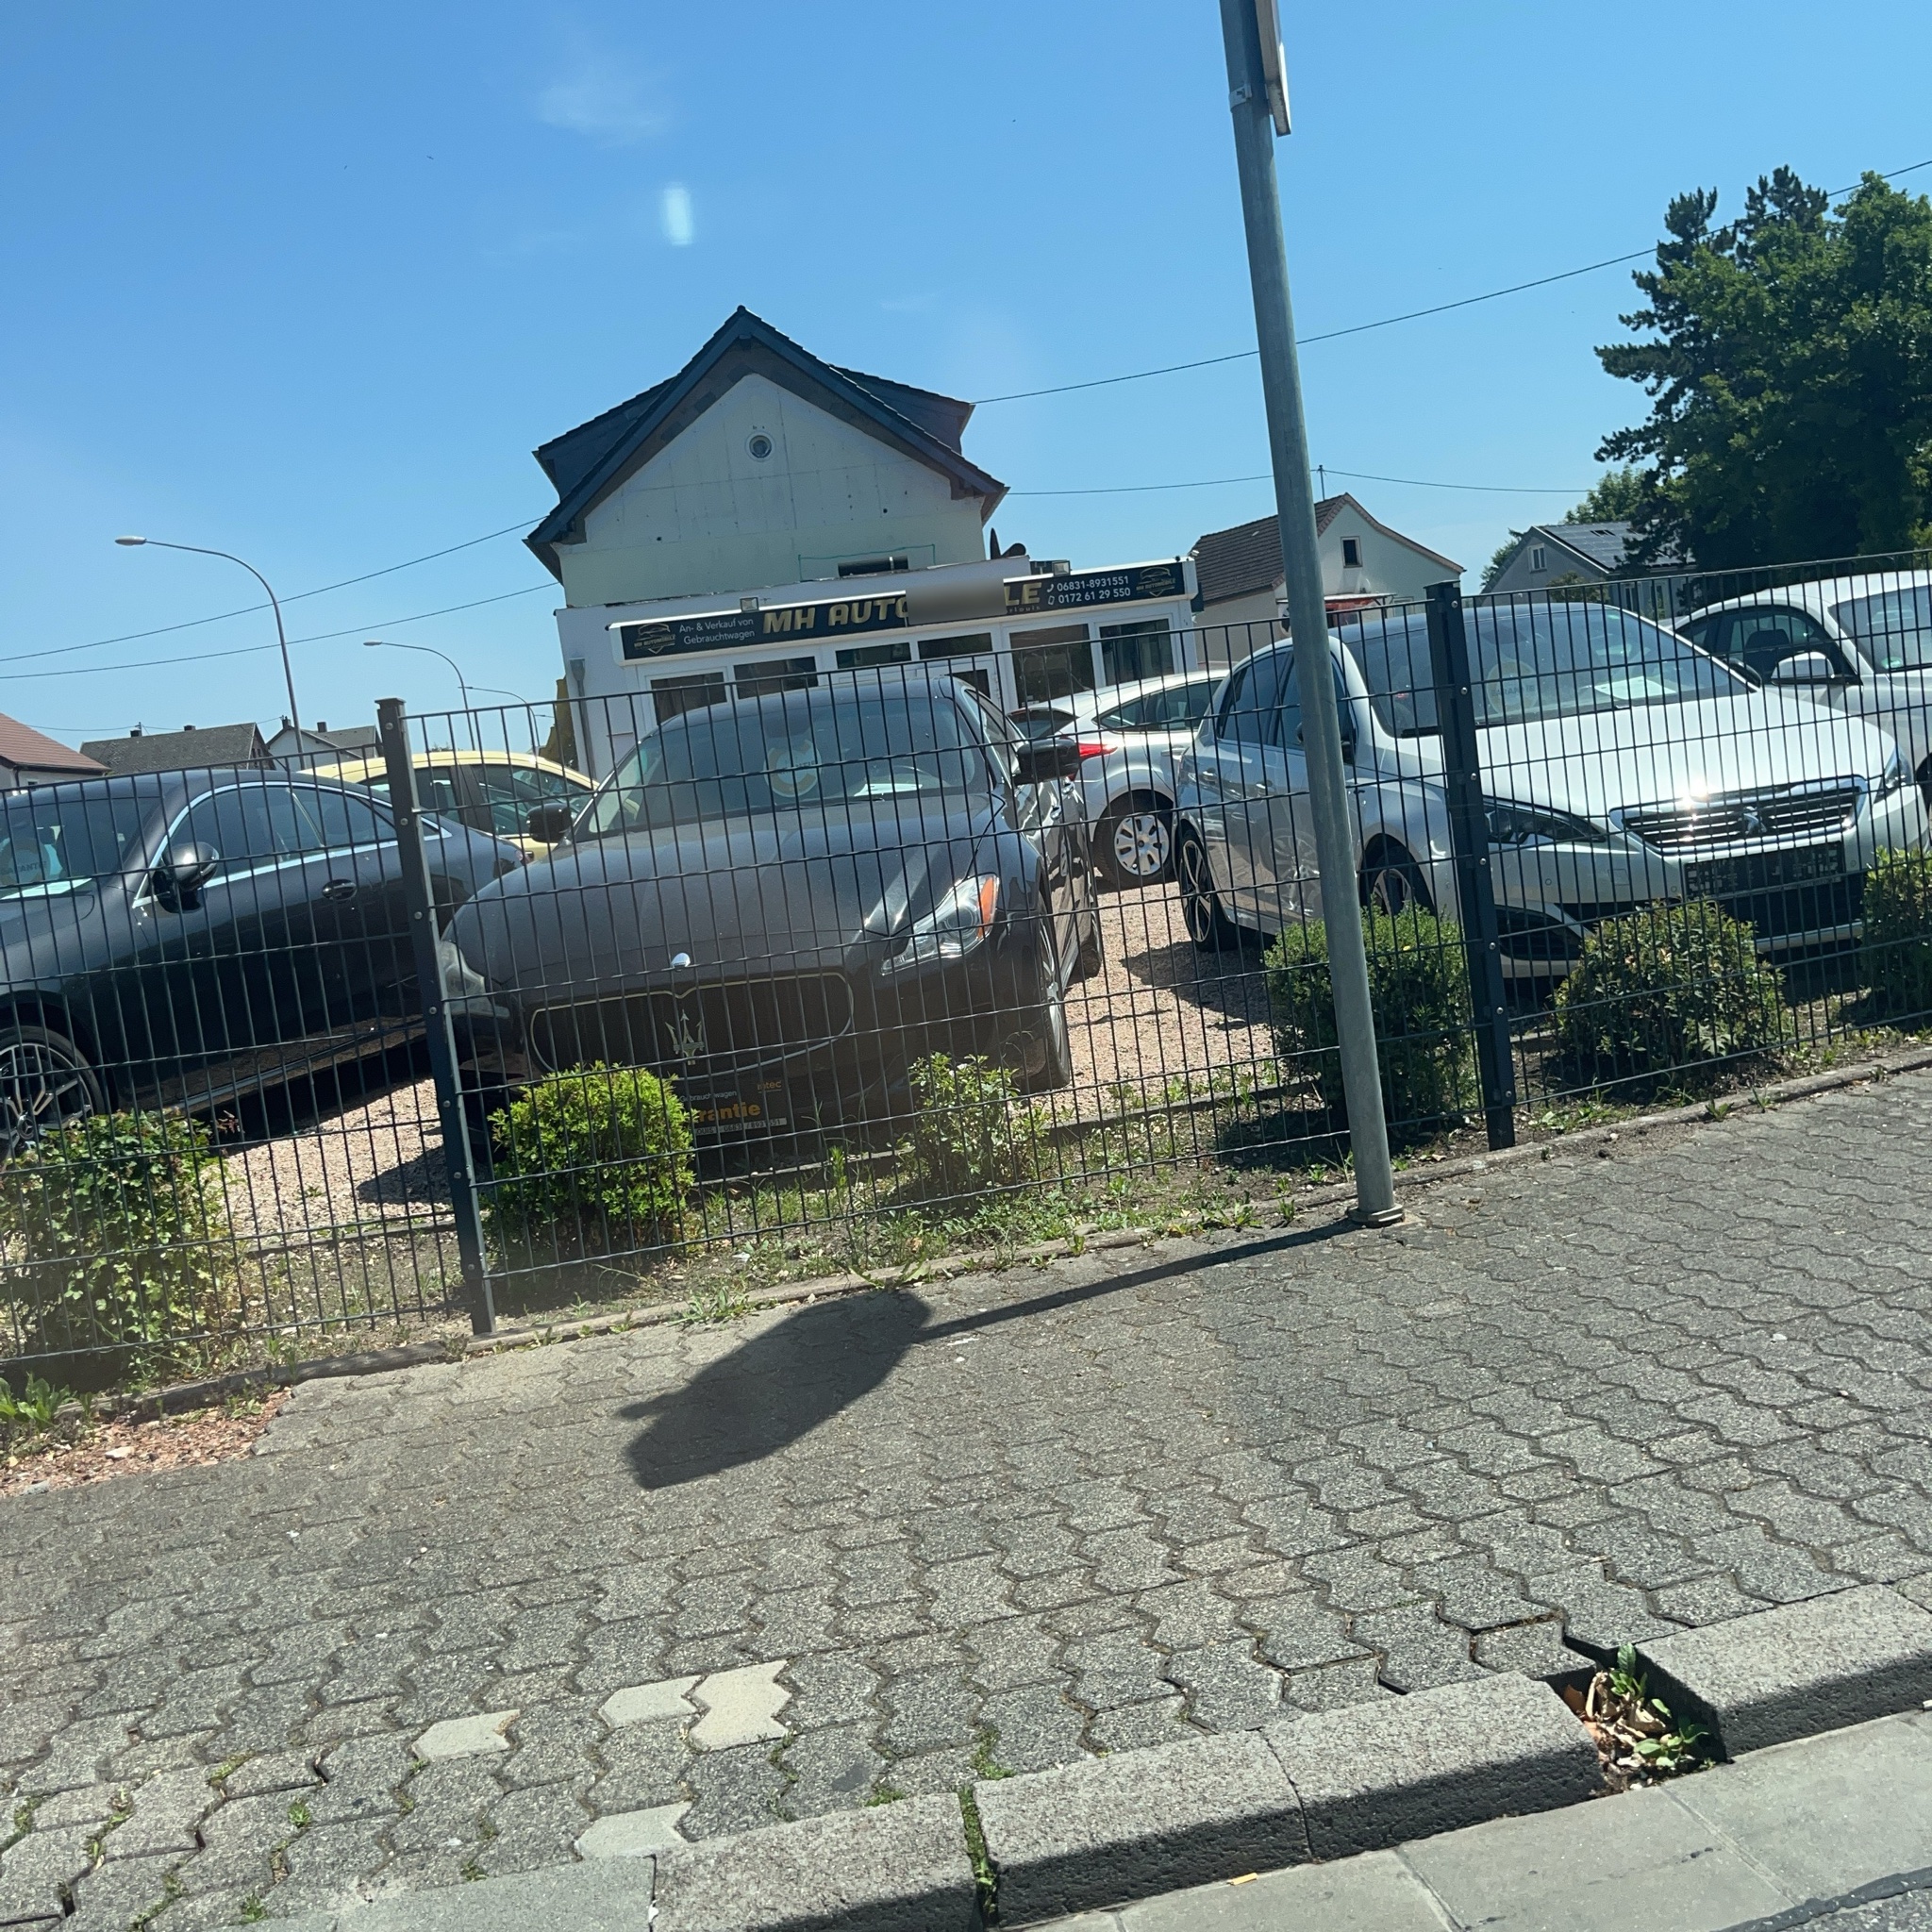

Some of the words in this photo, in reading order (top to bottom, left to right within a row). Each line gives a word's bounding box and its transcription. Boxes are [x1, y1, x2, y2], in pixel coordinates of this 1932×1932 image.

[1057, 575, 1129, 591] 06831-8931551
[1058, 592, 1082, 604] 0172
[1084, 591, 1095, 601] 61
[1098, 590, 1110, 599] 29
[1113, 587, 1131, 598] 550
[679, 624, 694, 633] An-
[696, 623, 704, 631] &
[704, 617, 736, 630] Verkauf
[763, 607, 815, 634] MH
[683, 630, 756, 644] Gebrauchtwagen
[679, 1091, 738, 1103] Gebrauchwagen
[698, 1101, 761, 1123] rantie
